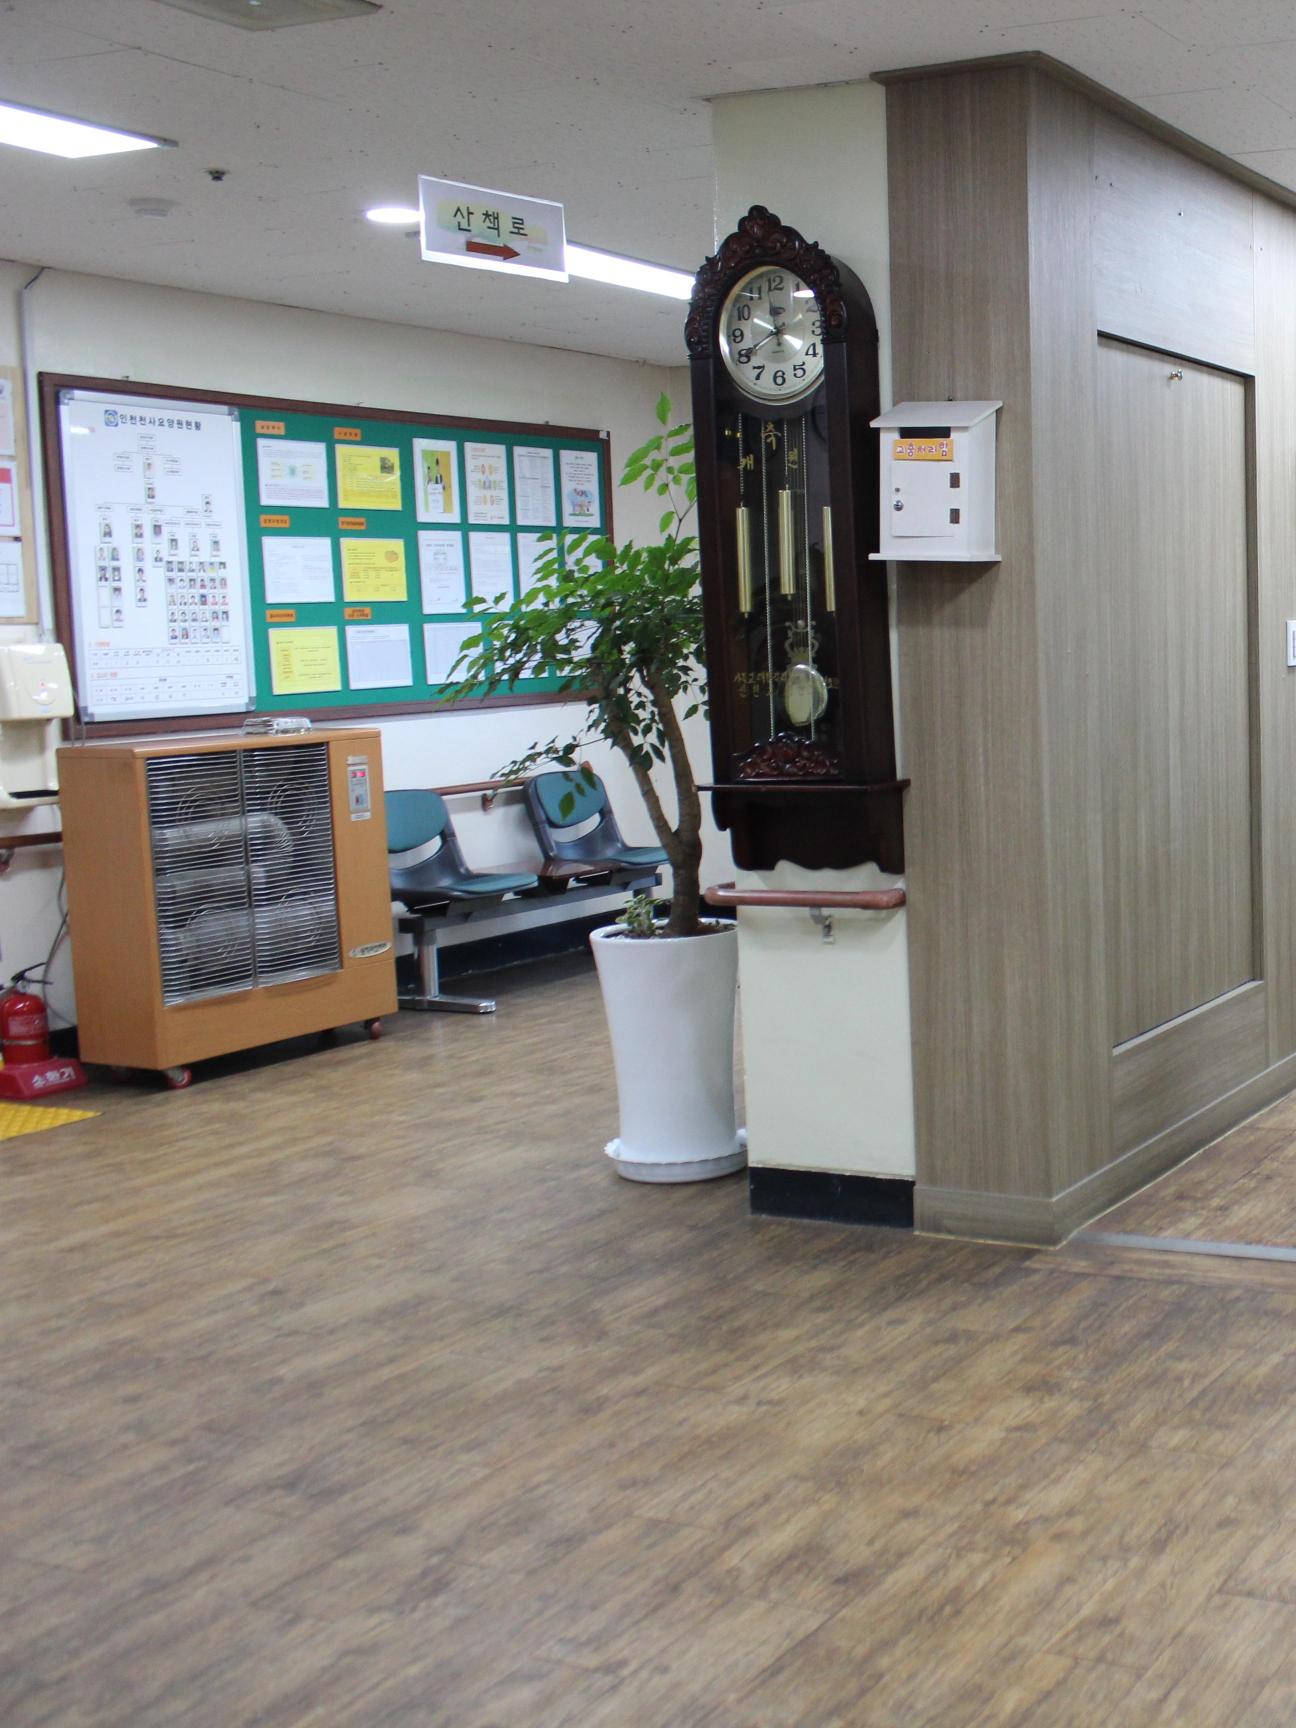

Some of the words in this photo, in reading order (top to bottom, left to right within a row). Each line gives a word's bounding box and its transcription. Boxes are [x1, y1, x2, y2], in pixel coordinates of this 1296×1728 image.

[453, 205, 529, 238] 산책로
[766, 275, 785, 292] 12
[748, 285, 763, 301] 11
[736, 303, 752, 321] 10
[731, 327, 745, 344] 9
[736, 347, 753, 365] 8
[804, 342, 820, 358] 4
[751, 364, 766, 381] 7
[772, 369, 787, 387] 6
[792, 361, 807, 379] 5
[895, 440, 949, 457] 고충처리함
